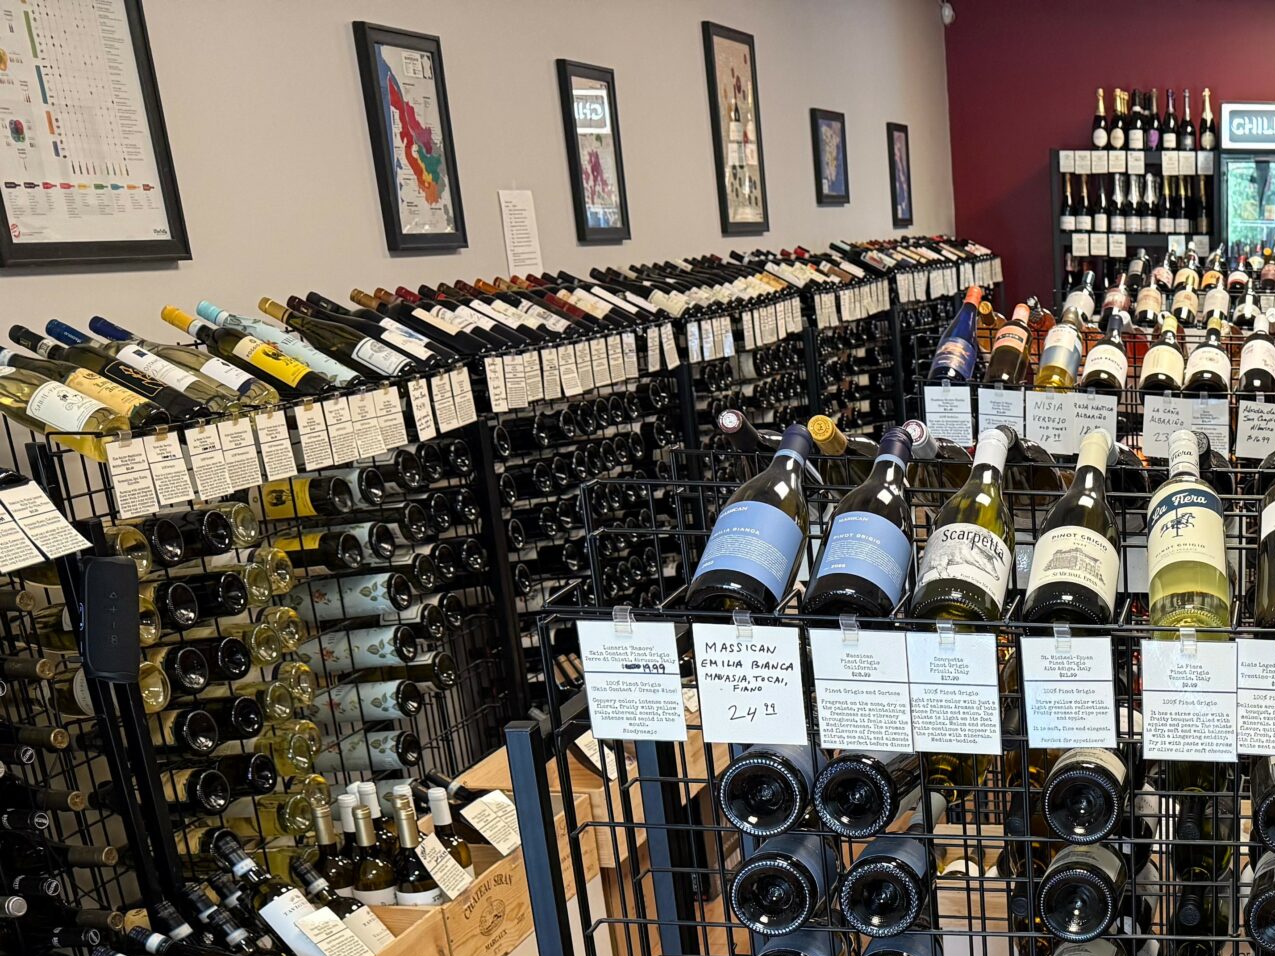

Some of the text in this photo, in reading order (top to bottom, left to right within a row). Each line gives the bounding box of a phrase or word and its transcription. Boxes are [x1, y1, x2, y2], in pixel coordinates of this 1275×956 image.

[1034, 403, 1063, 411] NISIA
[1032, 415, 1066, 424] VERDEJO
[1151, 492, 1207, 525] La Fiera
[857, 534, 881, 544] GRIGIO
[1081, 534, 1108, 551] GRIGIO
[941, 529, 1005, 562] Scarpetta
[1155, 545, 1175, 558] PINOT
[706, 642, 776, 654] MASSICAN
[643, 663, 665, 674] 19.99
[701, 659, 793, 671] EMILIA BIANCA
[753, 675, 788, 686] TOCAI,
[733, 684, 762, 692] FIANO
